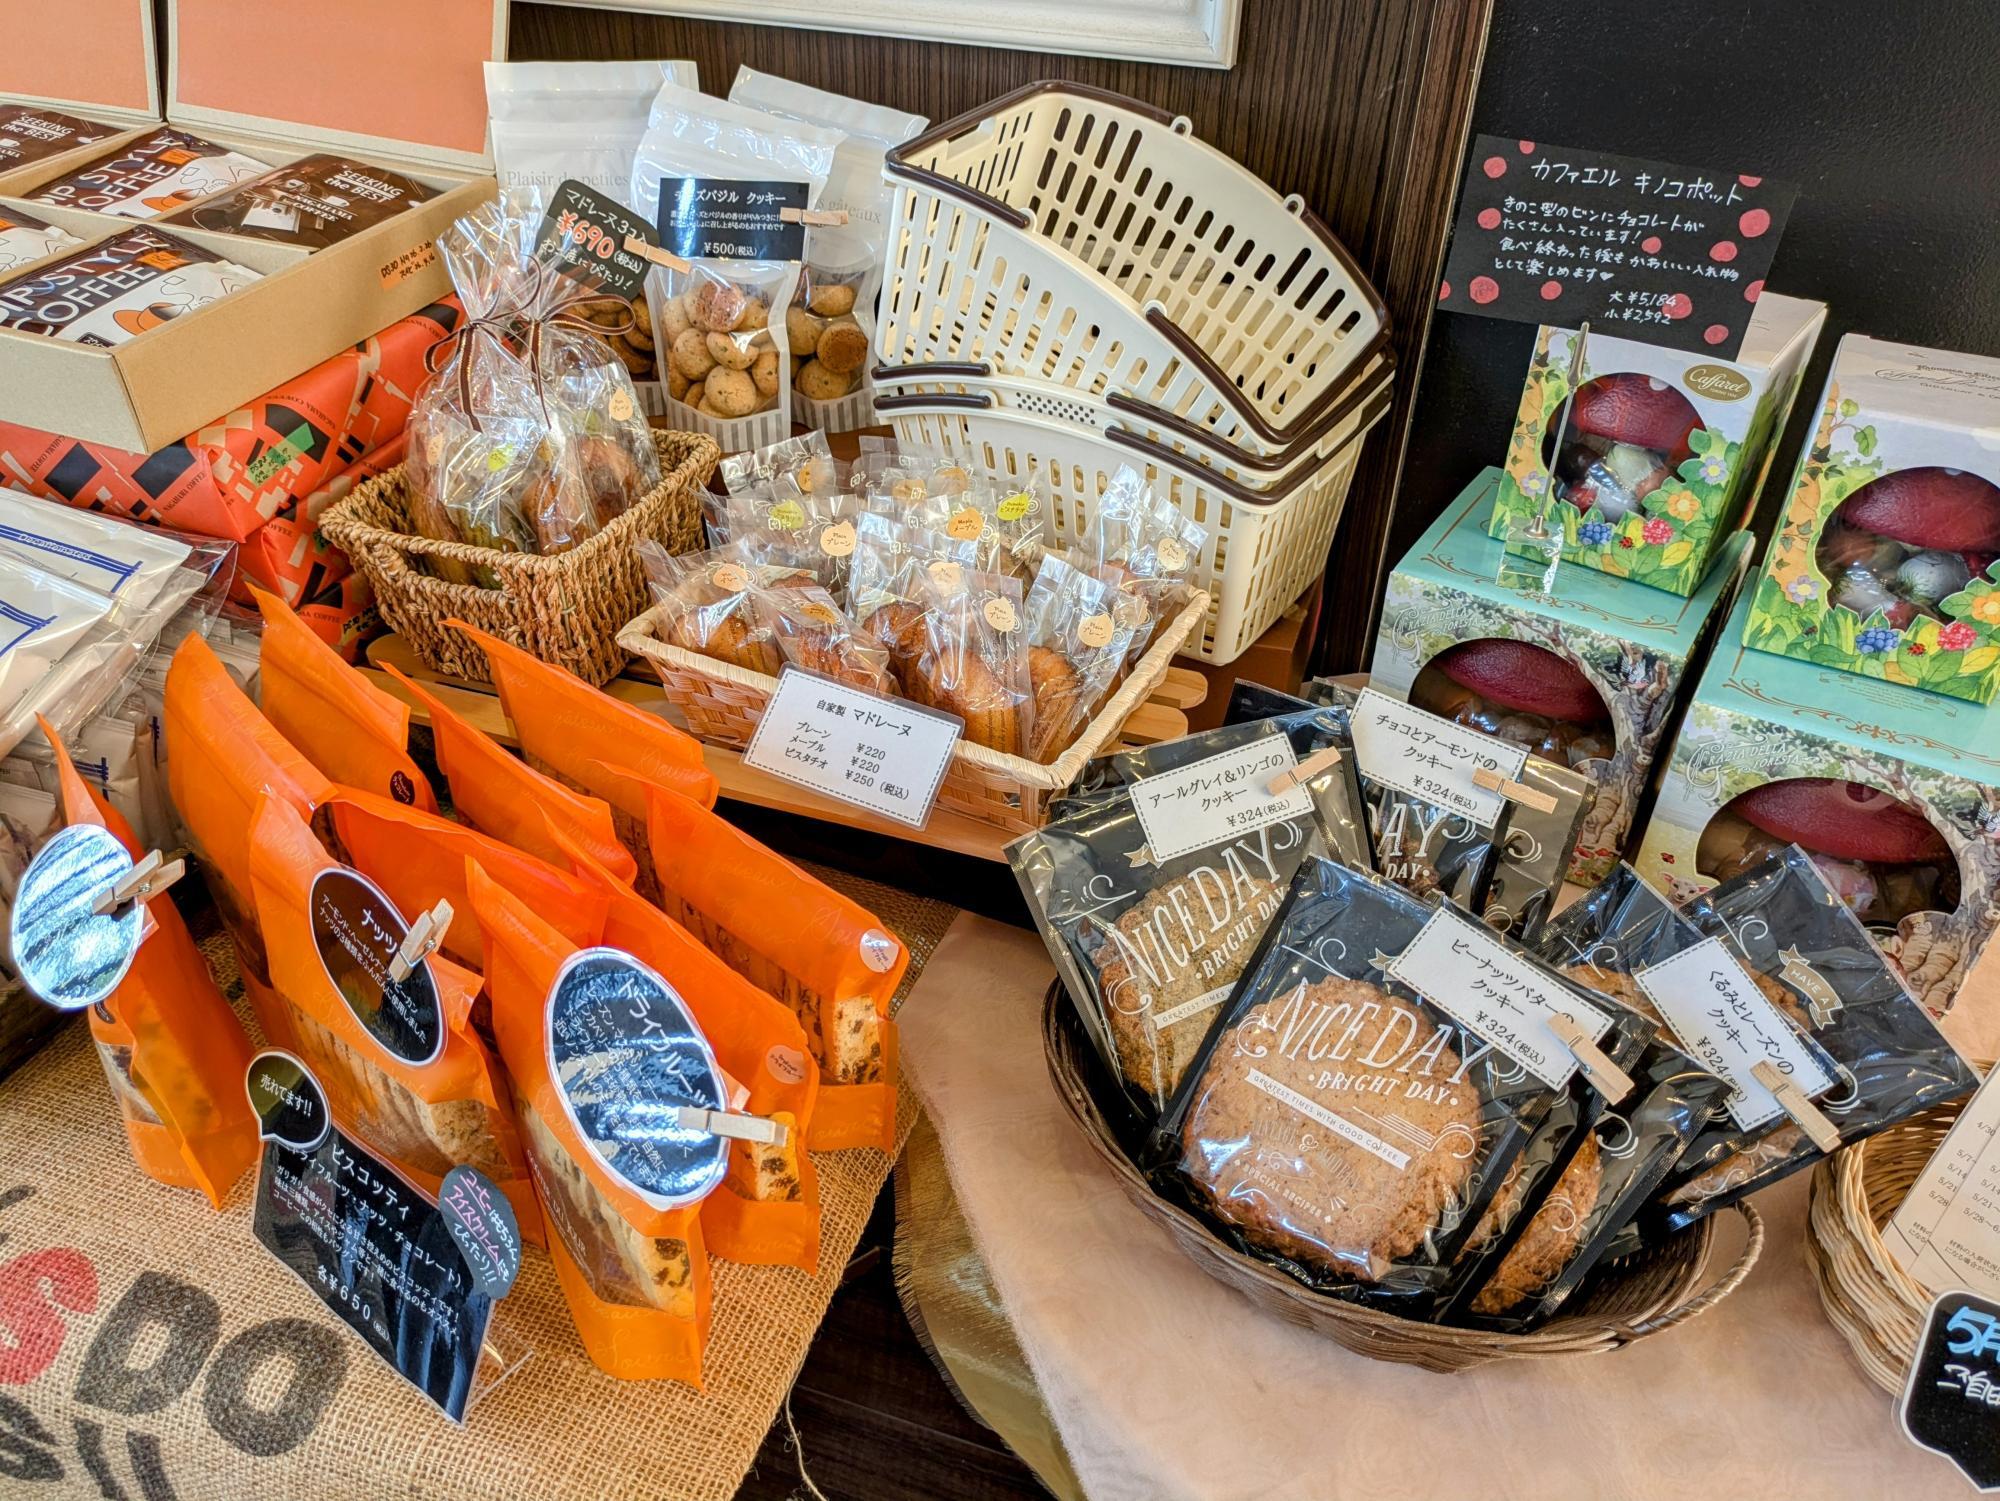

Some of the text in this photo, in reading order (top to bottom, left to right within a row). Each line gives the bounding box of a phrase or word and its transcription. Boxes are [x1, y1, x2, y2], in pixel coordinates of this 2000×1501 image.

[17, 114, 75, 135] SEEKING
[25, 126, 63, 141] BEST
[65, 163, 177, 212] OFFEE
[324, 177, 393, 203] the BEST
[338, 169, 404, 196] SEEKING
[506, 171, 554, 187] Plaisir
[1634, 171, 1744, 206] キノコポット
[746, 191, 787, 206] クッキー
[556, 208, 644, 274] ¥690 (税込)
[1502, 217, 1643, 245] たくさん入っています!
[41, 231, 170, 286] STYLE
[14, 264, 158, 336] COFFEE
[1608, 290, 1624, 303] 大
[1689, 368, 1747, 393] Caffarel
[1438, 606, 1467, 624] DELLA
[816, 699, 913, 737] 自家製 マドレーヌ
[789, 735, 880, 774] メープル ¥220
[795, 720, 886, 761] プレーン ¥220
[1376, 714, 1499, 772] チョコとアーモンドの
[1403, 745, 1454, 771] クッキー
[1749, 743, 1787, 756] DELLA
[784, 747, 911, 801] ピスタチオ ¥250 (税込)
[1148, 753, 1285, 809] アールグレイ&リンゴの
[1200, 786, 1248, 813] クッキー
[1385, 862, 1424, 881] DAY
[1107, 825, 1281, 988] NICE DAY
[361, 907, 399, 955] ナッツ
[1201, 913, 1257, 980] BRIGHT
[1470, 978, 1526, 1017] クッキー
[1790, 969, 1830, 1005] HAVE A
[1257, 976, 1496, 1085] NICE DAY
[1706, 1007, 1749, 1055] クッキー
[1707, 969, 1796, 1076] くるみとレーズンの
[259, 1073, 313, 1117] 売れてます!!
[1315, 1070, 1452, 1107] BRIGHT DAY
[1291, 1095, 1315, 1114] TIMES
[1315, 1110, 1338, 1128] WITH
[1338, 1122, 1365, 1142] GOOD
